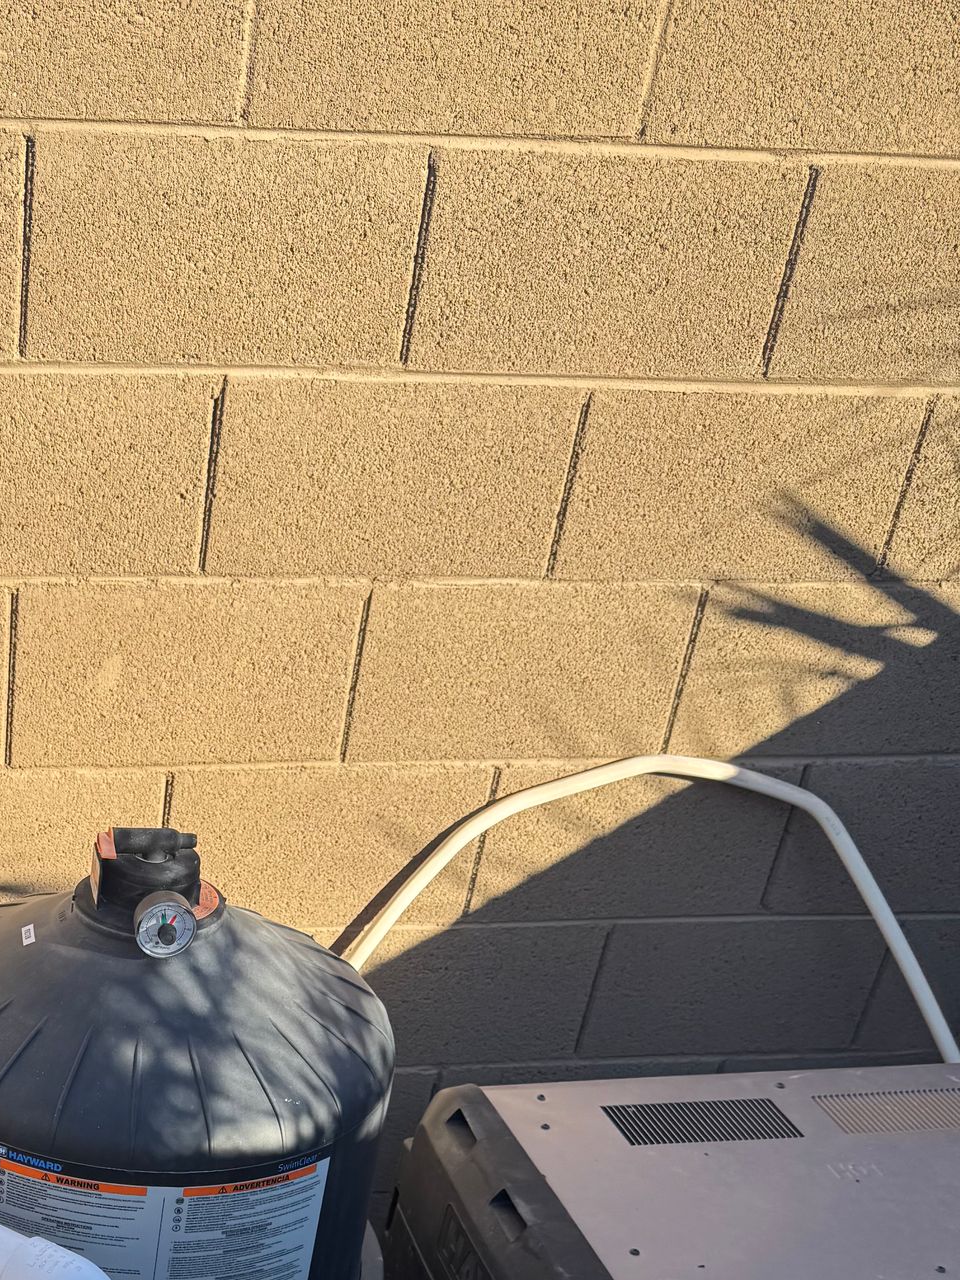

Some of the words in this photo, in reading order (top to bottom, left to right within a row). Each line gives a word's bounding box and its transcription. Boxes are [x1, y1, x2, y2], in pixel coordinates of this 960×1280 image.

[8, 1151, 63, 1172] HAYWARD
[277, 1154, 318, 1173] SwimClear
[55, 1175, 100, 1191] WARNING
[232, 1174, 290, 1192] ADVERTENCIA
